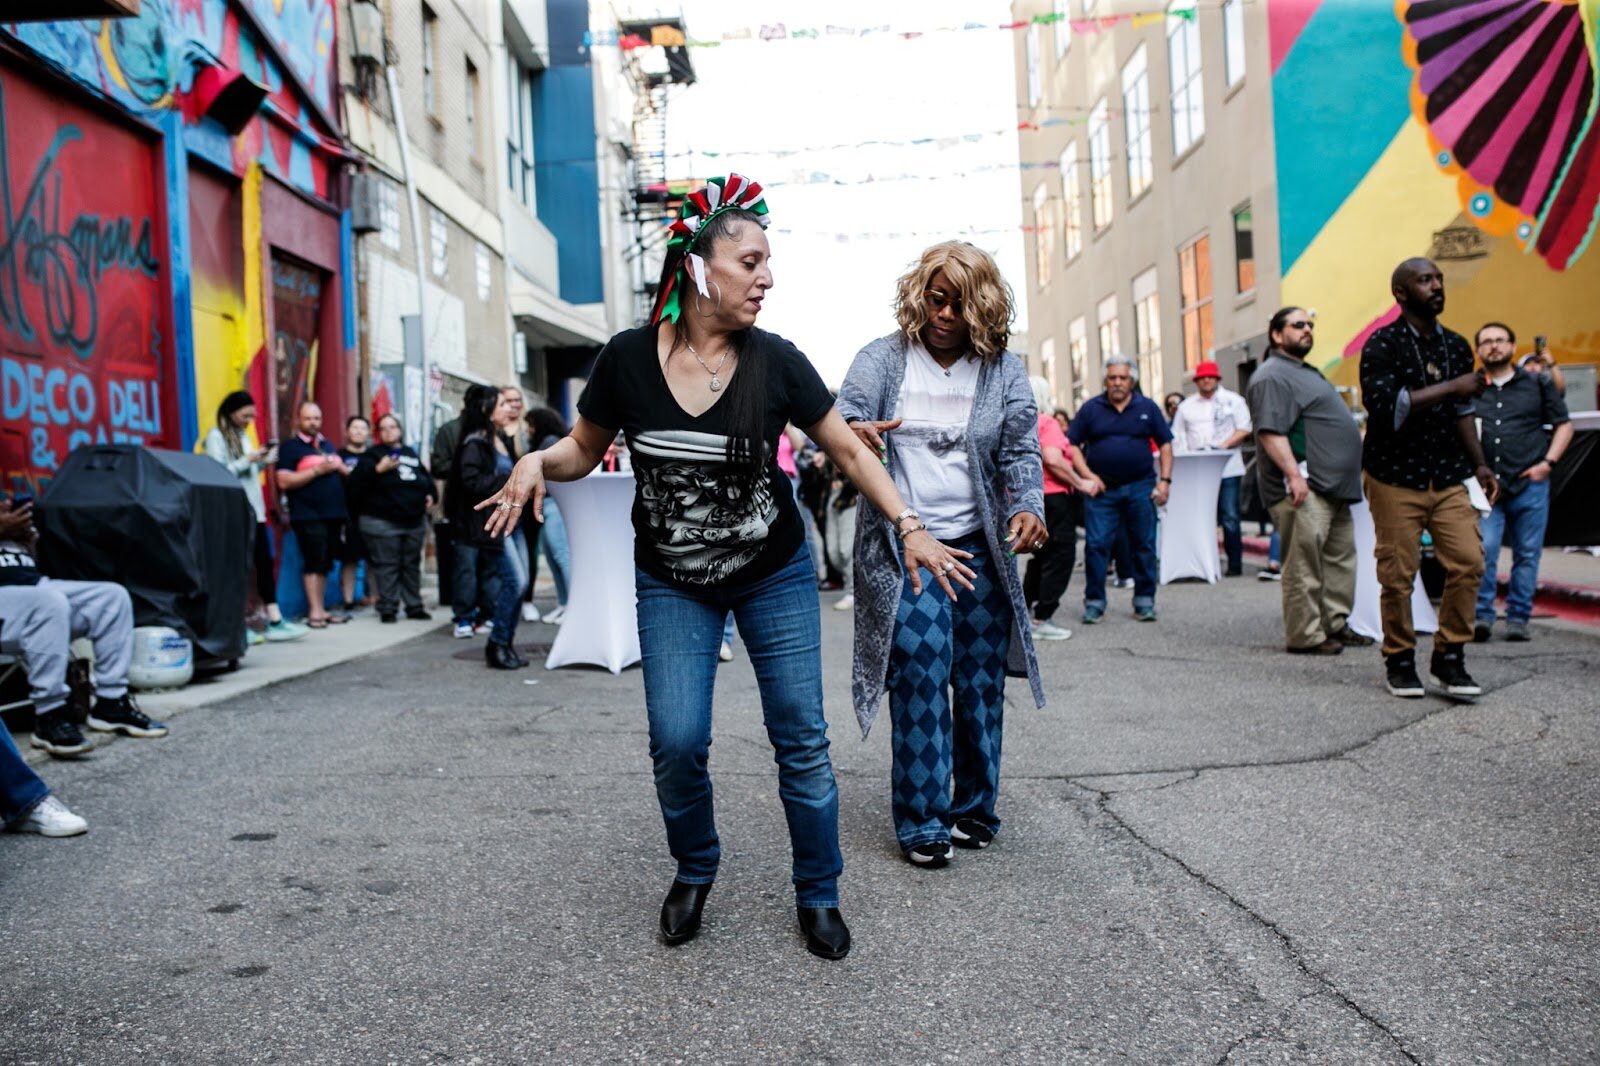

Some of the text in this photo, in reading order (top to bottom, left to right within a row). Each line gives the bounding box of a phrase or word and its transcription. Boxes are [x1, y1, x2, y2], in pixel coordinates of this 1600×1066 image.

[2, 357, 161, 434] DECO DELI
[30, 426, 58, 470] &
